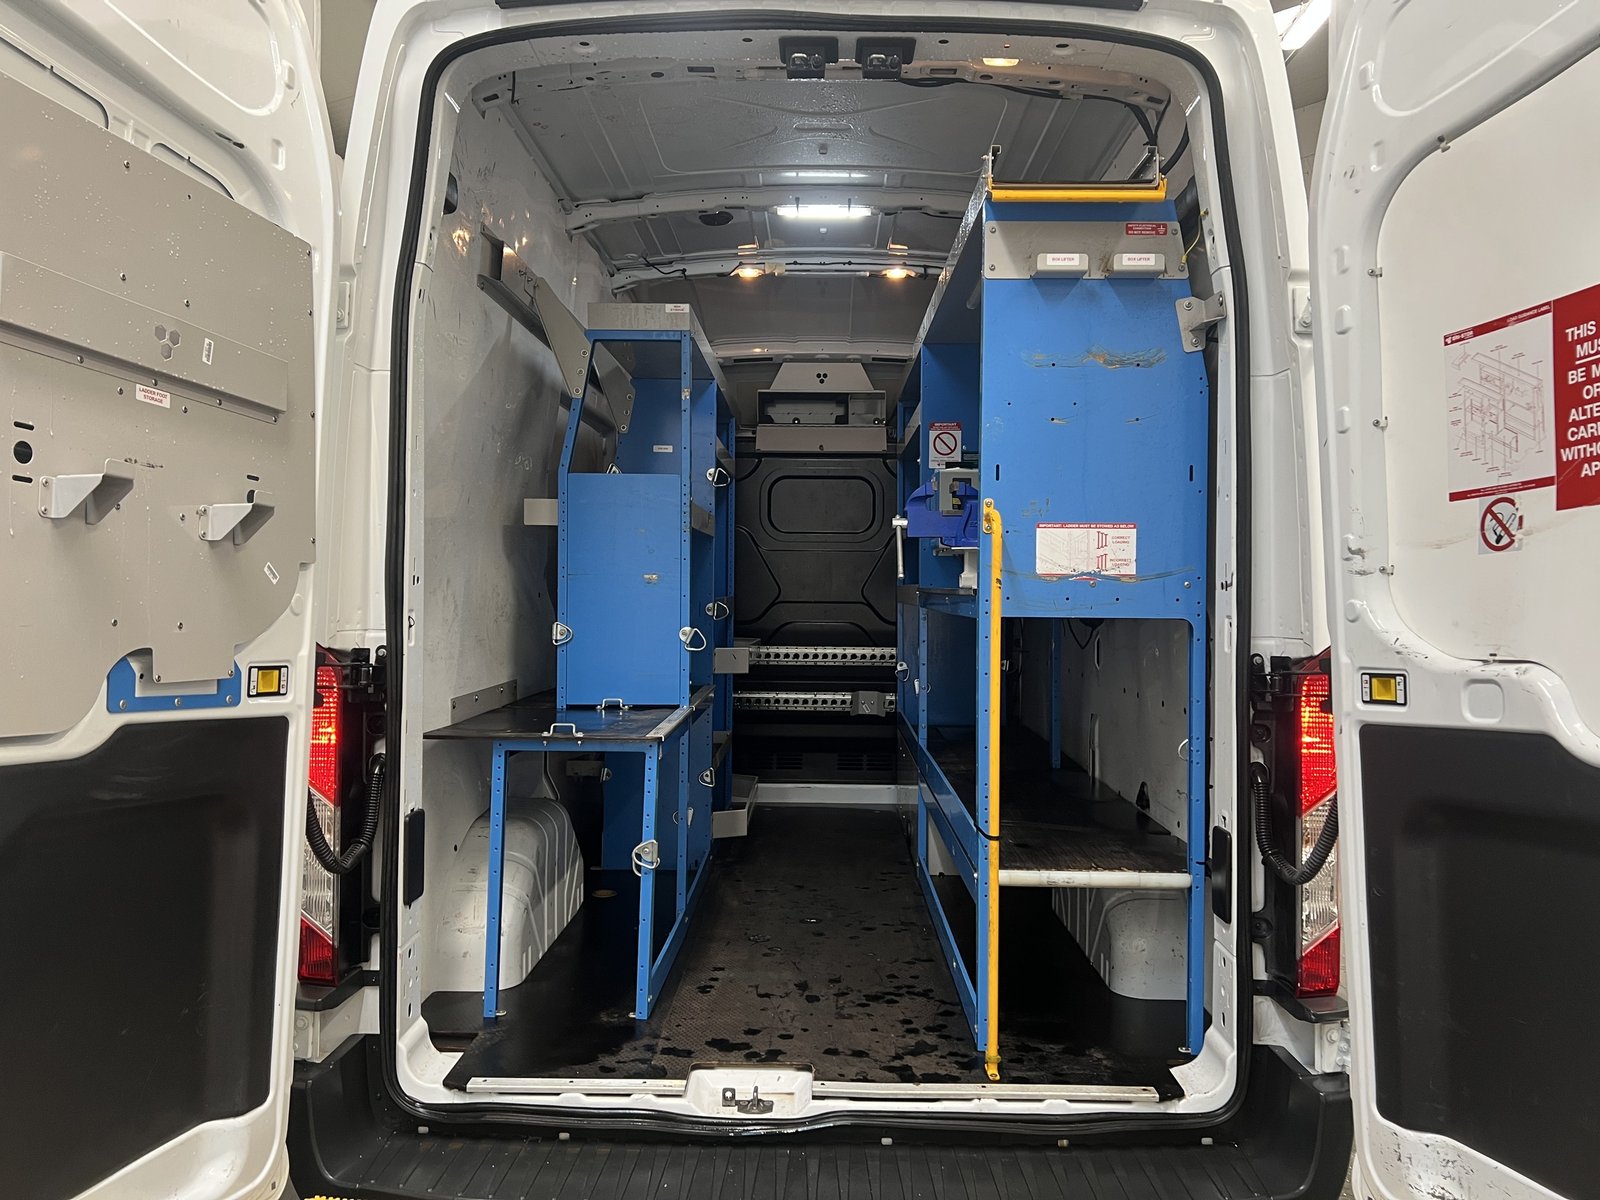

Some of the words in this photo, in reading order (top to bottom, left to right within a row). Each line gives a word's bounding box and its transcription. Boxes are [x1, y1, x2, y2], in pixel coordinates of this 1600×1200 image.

[1565, 320, 1596, 342] THIS
[1576, 338, 1600, 358] MU
[1568, 367, 1587, 385] BE
[139, 387, 156, 395] LADDER
[143, 394, 163, 404] STORAGE
[1567, 421, 1600, 441] CAR
